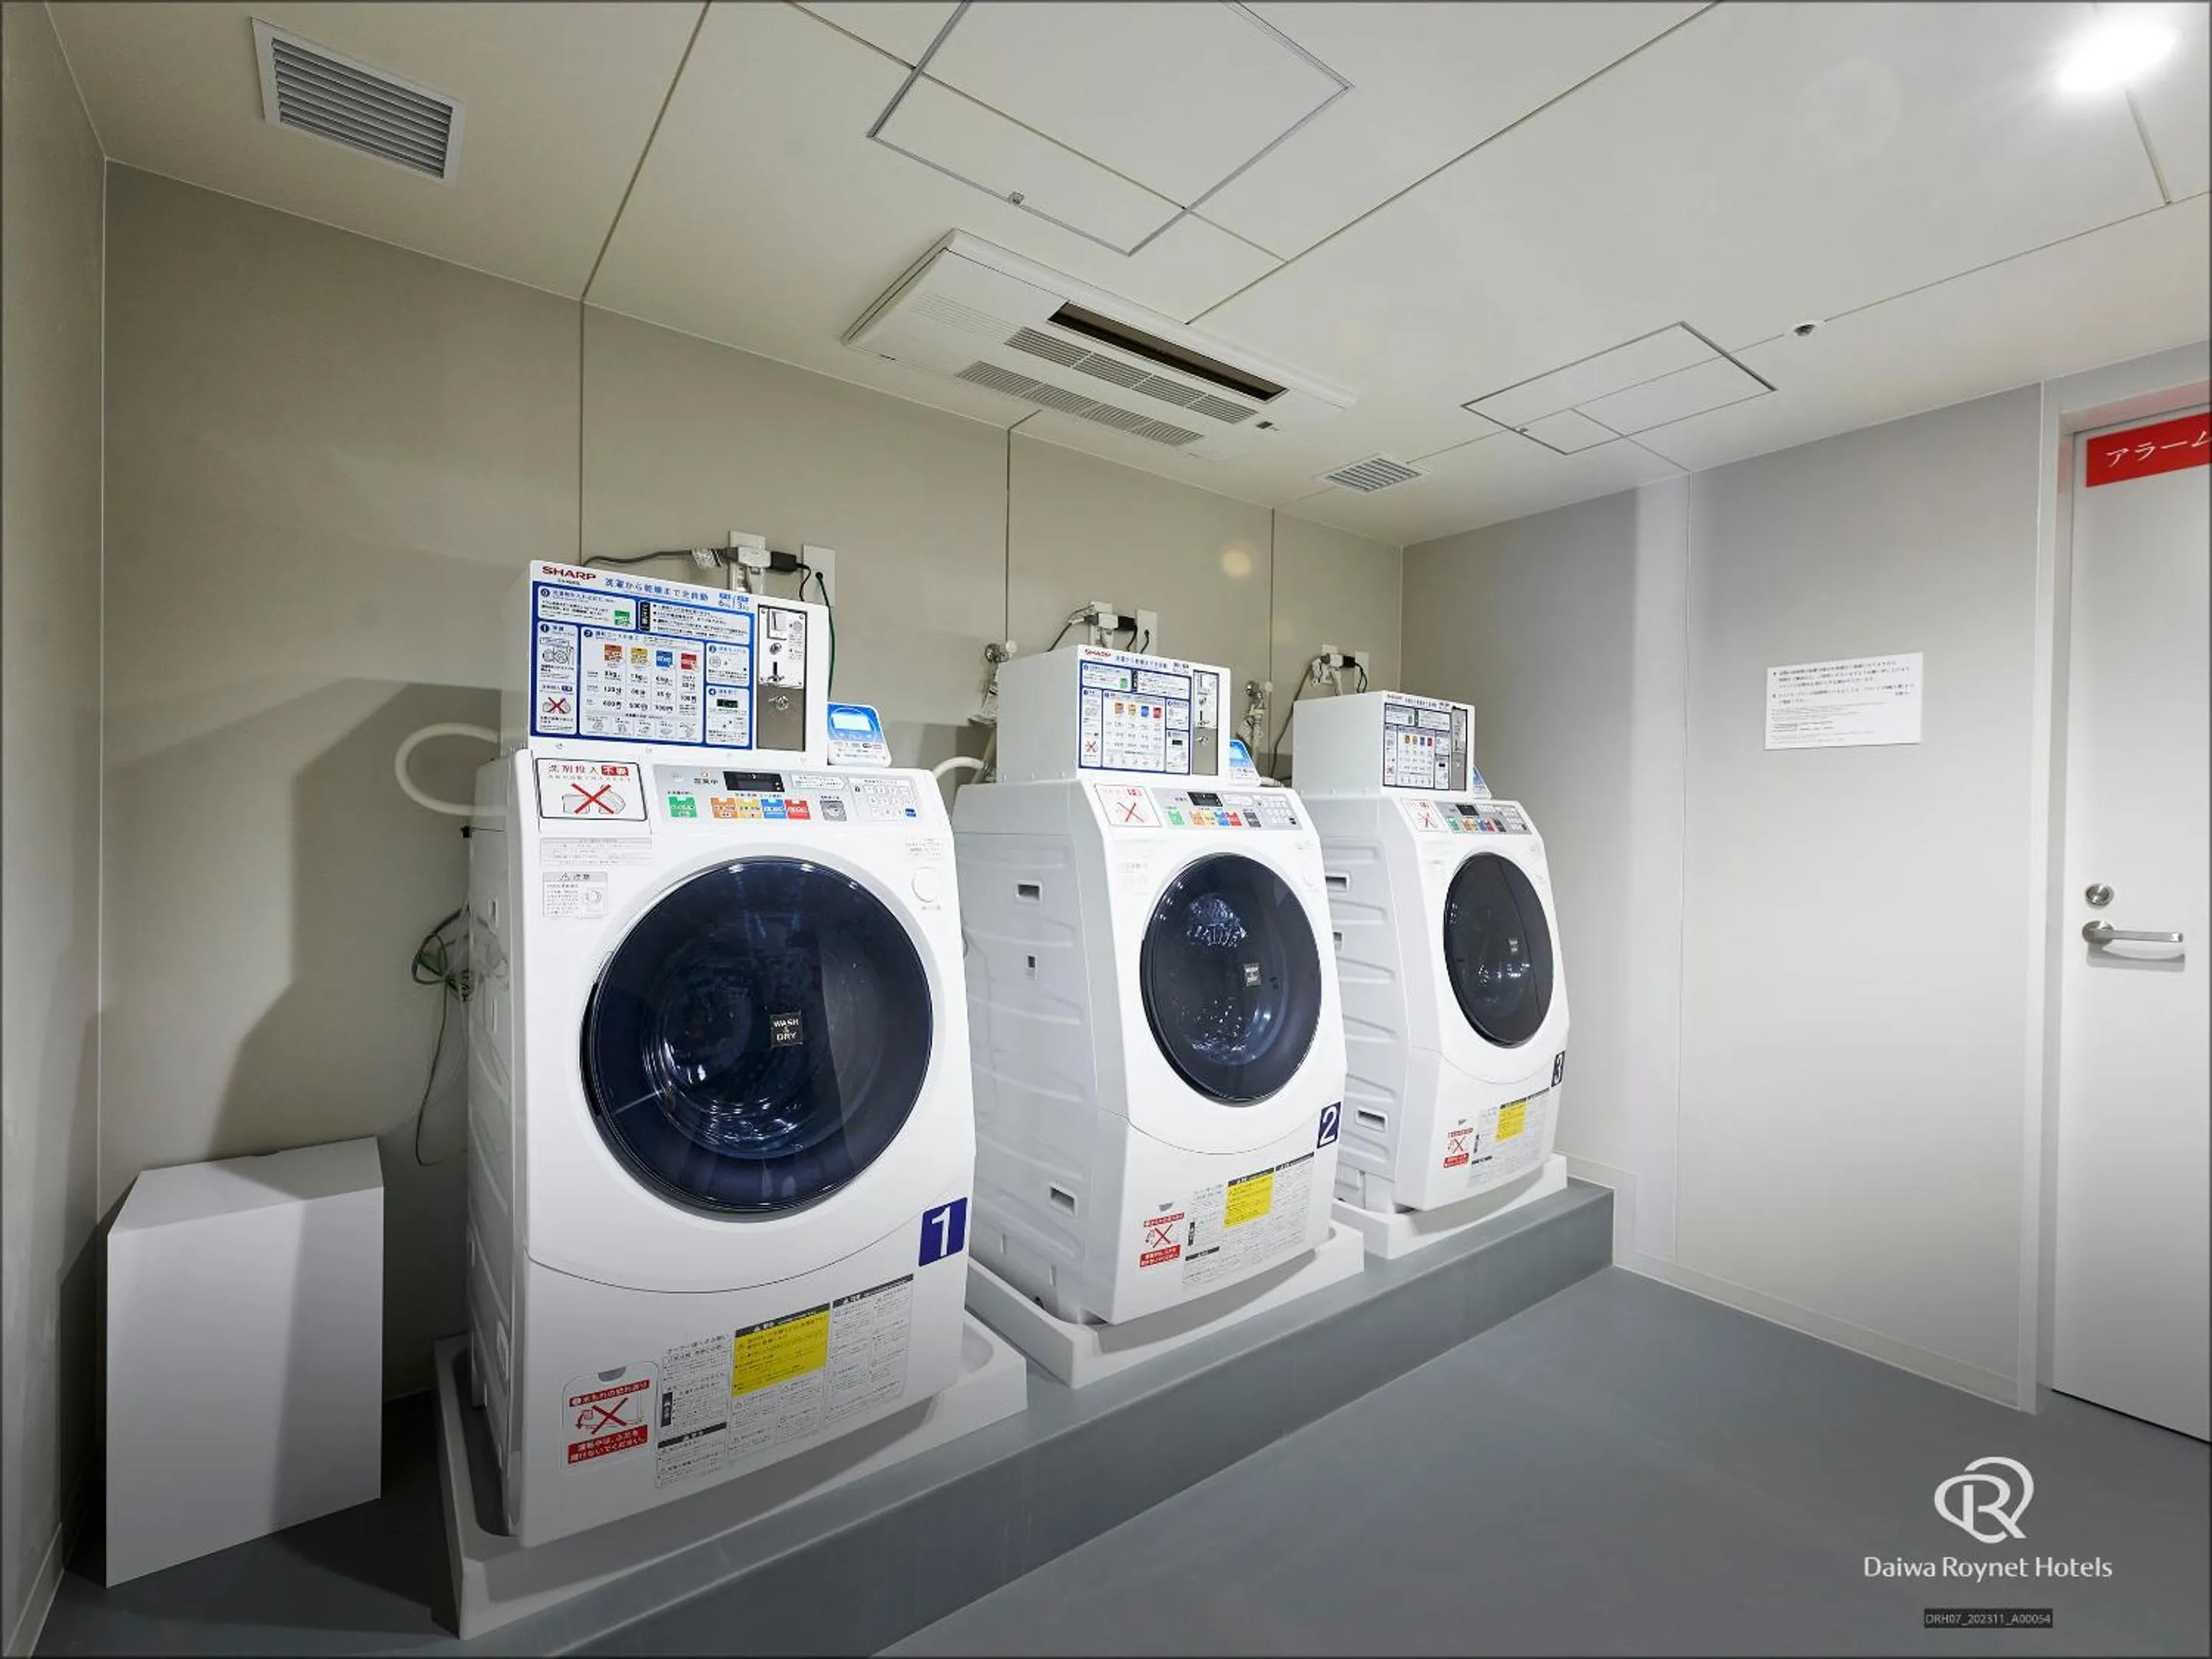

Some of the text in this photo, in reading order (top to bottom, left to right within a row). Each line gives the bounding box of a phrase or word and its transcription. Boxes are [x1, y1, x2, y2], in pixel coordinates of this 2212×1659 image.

[542, 565, 597, 580] SHARP
[773, 1018, 799, 1028] WASH
[777, 1032, 796, 1041] DRY
[1554, 1054, 1563, 1084] 3
[1320, 1105, 1337, 1146] 2
[931, 1206, 950, 1257] 1
